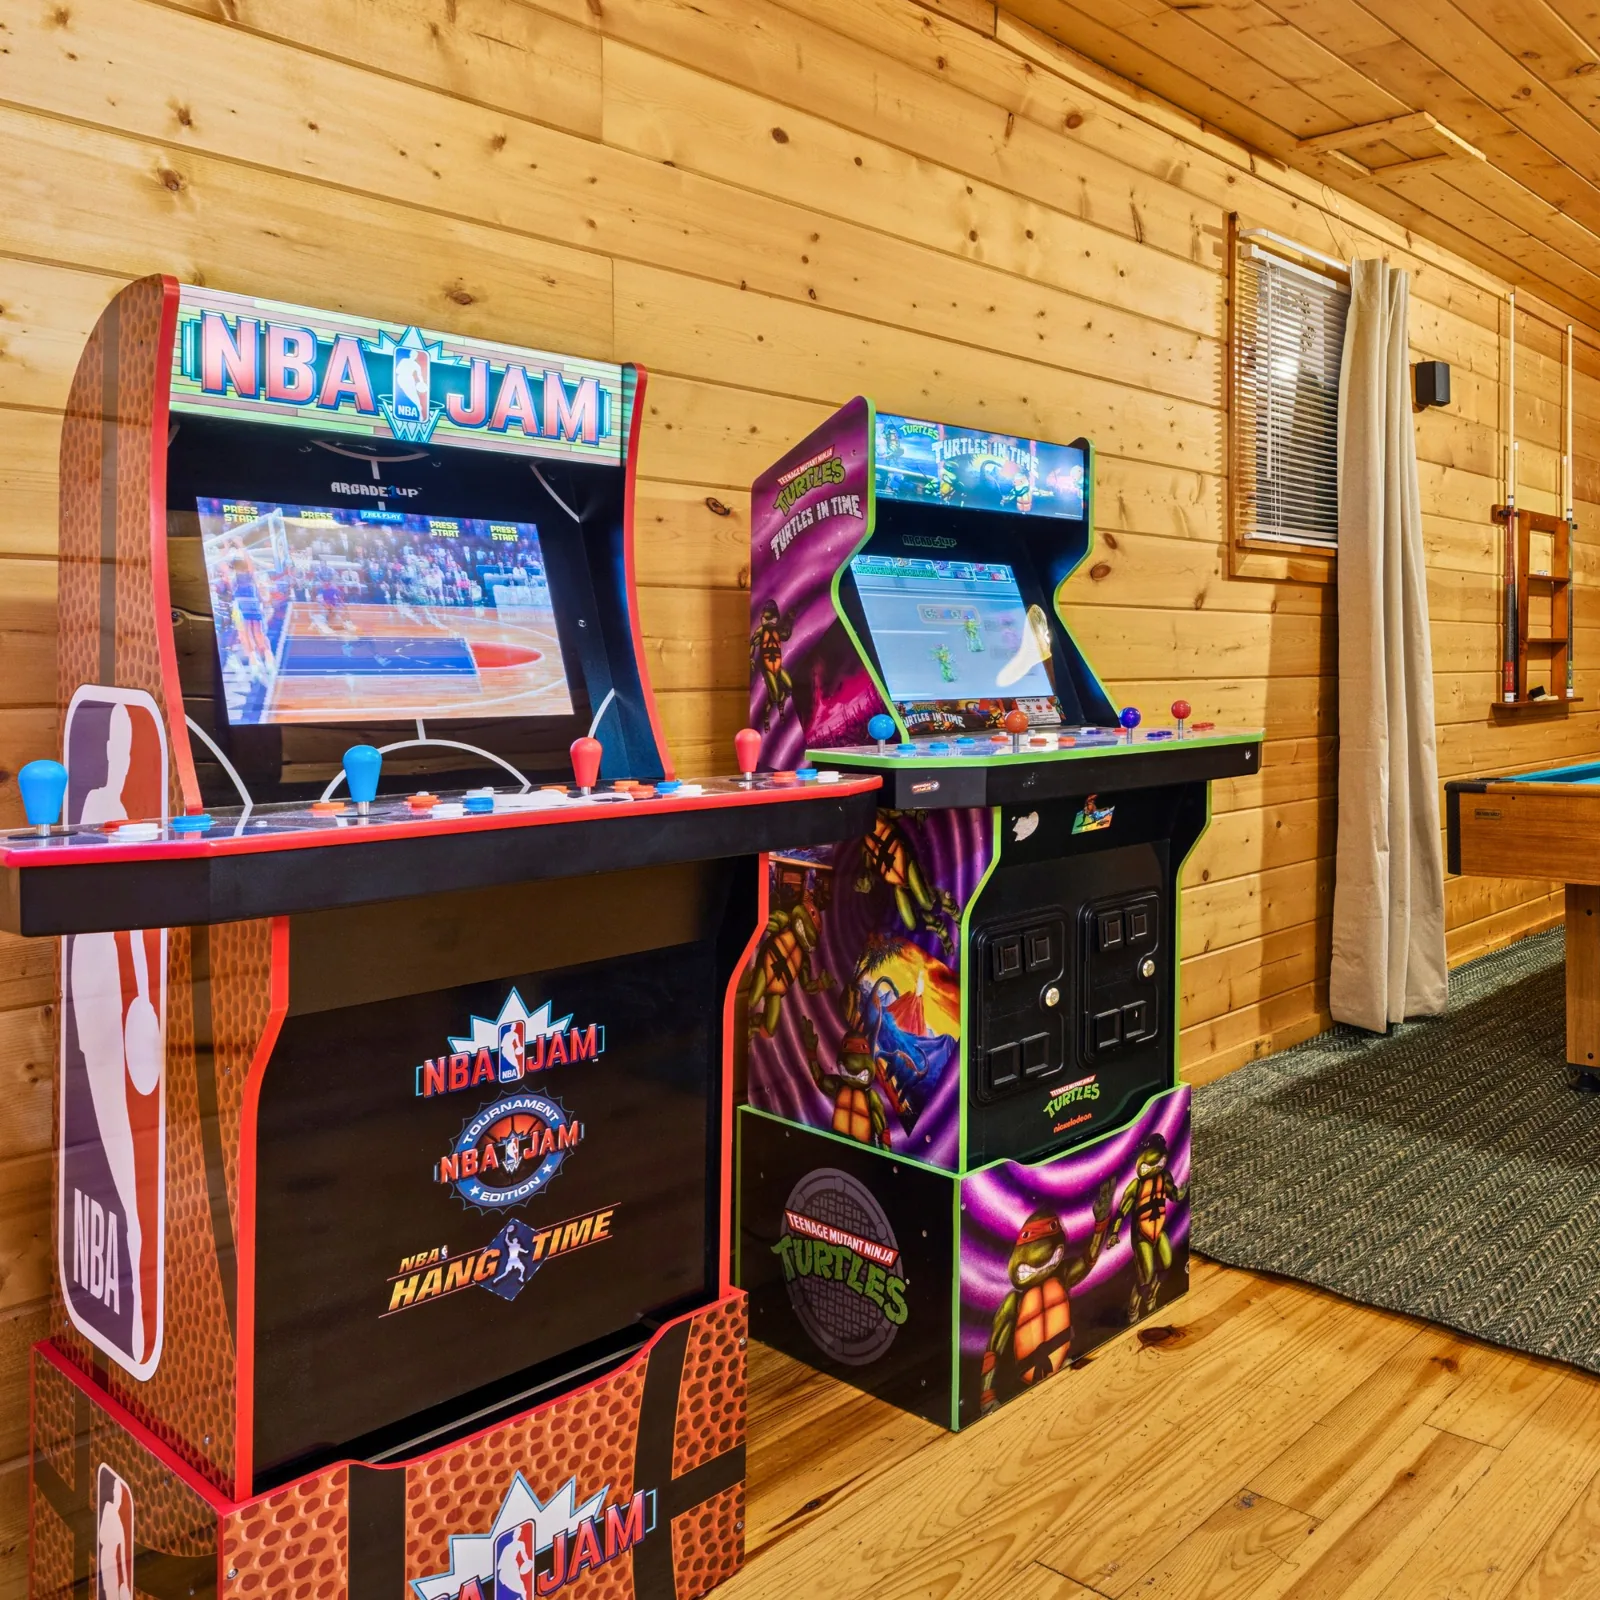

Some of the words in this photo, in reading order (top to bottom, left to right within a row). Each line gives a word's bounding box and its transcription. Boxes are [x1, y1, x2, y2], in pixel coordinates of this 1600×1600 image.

[200, 309, 381, 415] NBA
[445, 355, 600, 446] JAM
[397, 404, 418, 418] NBA
[899, 424, 939, 440] TURTLES
[931, 437, 988, 464] TURTLES
[992, 442, 1009, 457] IN
[1008, 446, 1039, 479] TIME
[773, 457, 845, 517] TURTLES
[222, 504, 258, 515] PRESS
[224, 513, 260, 524] START
[301, 510, 334, 521] PRESS
[429, 520, 459, 530] PRESS
[431, 529, 460, 538] START
[490, 525, 517, 534] PRESS
[491, 533, 519, 542] START
[770, 507, 814, 560] TURTLES
[816, 499, 830, 521] IN
[831, 494, 863, 520] TIME
[903, 712, 931, 729] URTLES
[942, 712, 967, 729] TIME
[423, 1047, 496, 1099] NBA
[526, 1023, 599, 1074] JAM
[501, 1068, 517, 1080] NBA
[1042, 1083, 1100, 1119] TURTLES
[463, 1099, 560, 1145] TOURNAMENT
[1053, 1112, 1093, 1134] nickelodeon
[440, 1143, 499, 1184] NBA
[523, 1121, 581, 1160] JAM
[479, 1176, 541, 1203] EDITION
[74, 1187, 120, 1316] NBA
[787, 1212, 829, 1240] TEENAGE
[828, 1230, 864, 1252] MUTANT
[864, 1242, 894, 1264] NINJA
[388, 1249, 501, 1312] HANG
[532, 1210, 614, 1261] TIME
[399, 1246, 440, 1273] NBA
[770, 1234, 909, 1325] TURTLES
[535, 1488, 646, 1597] JAM
